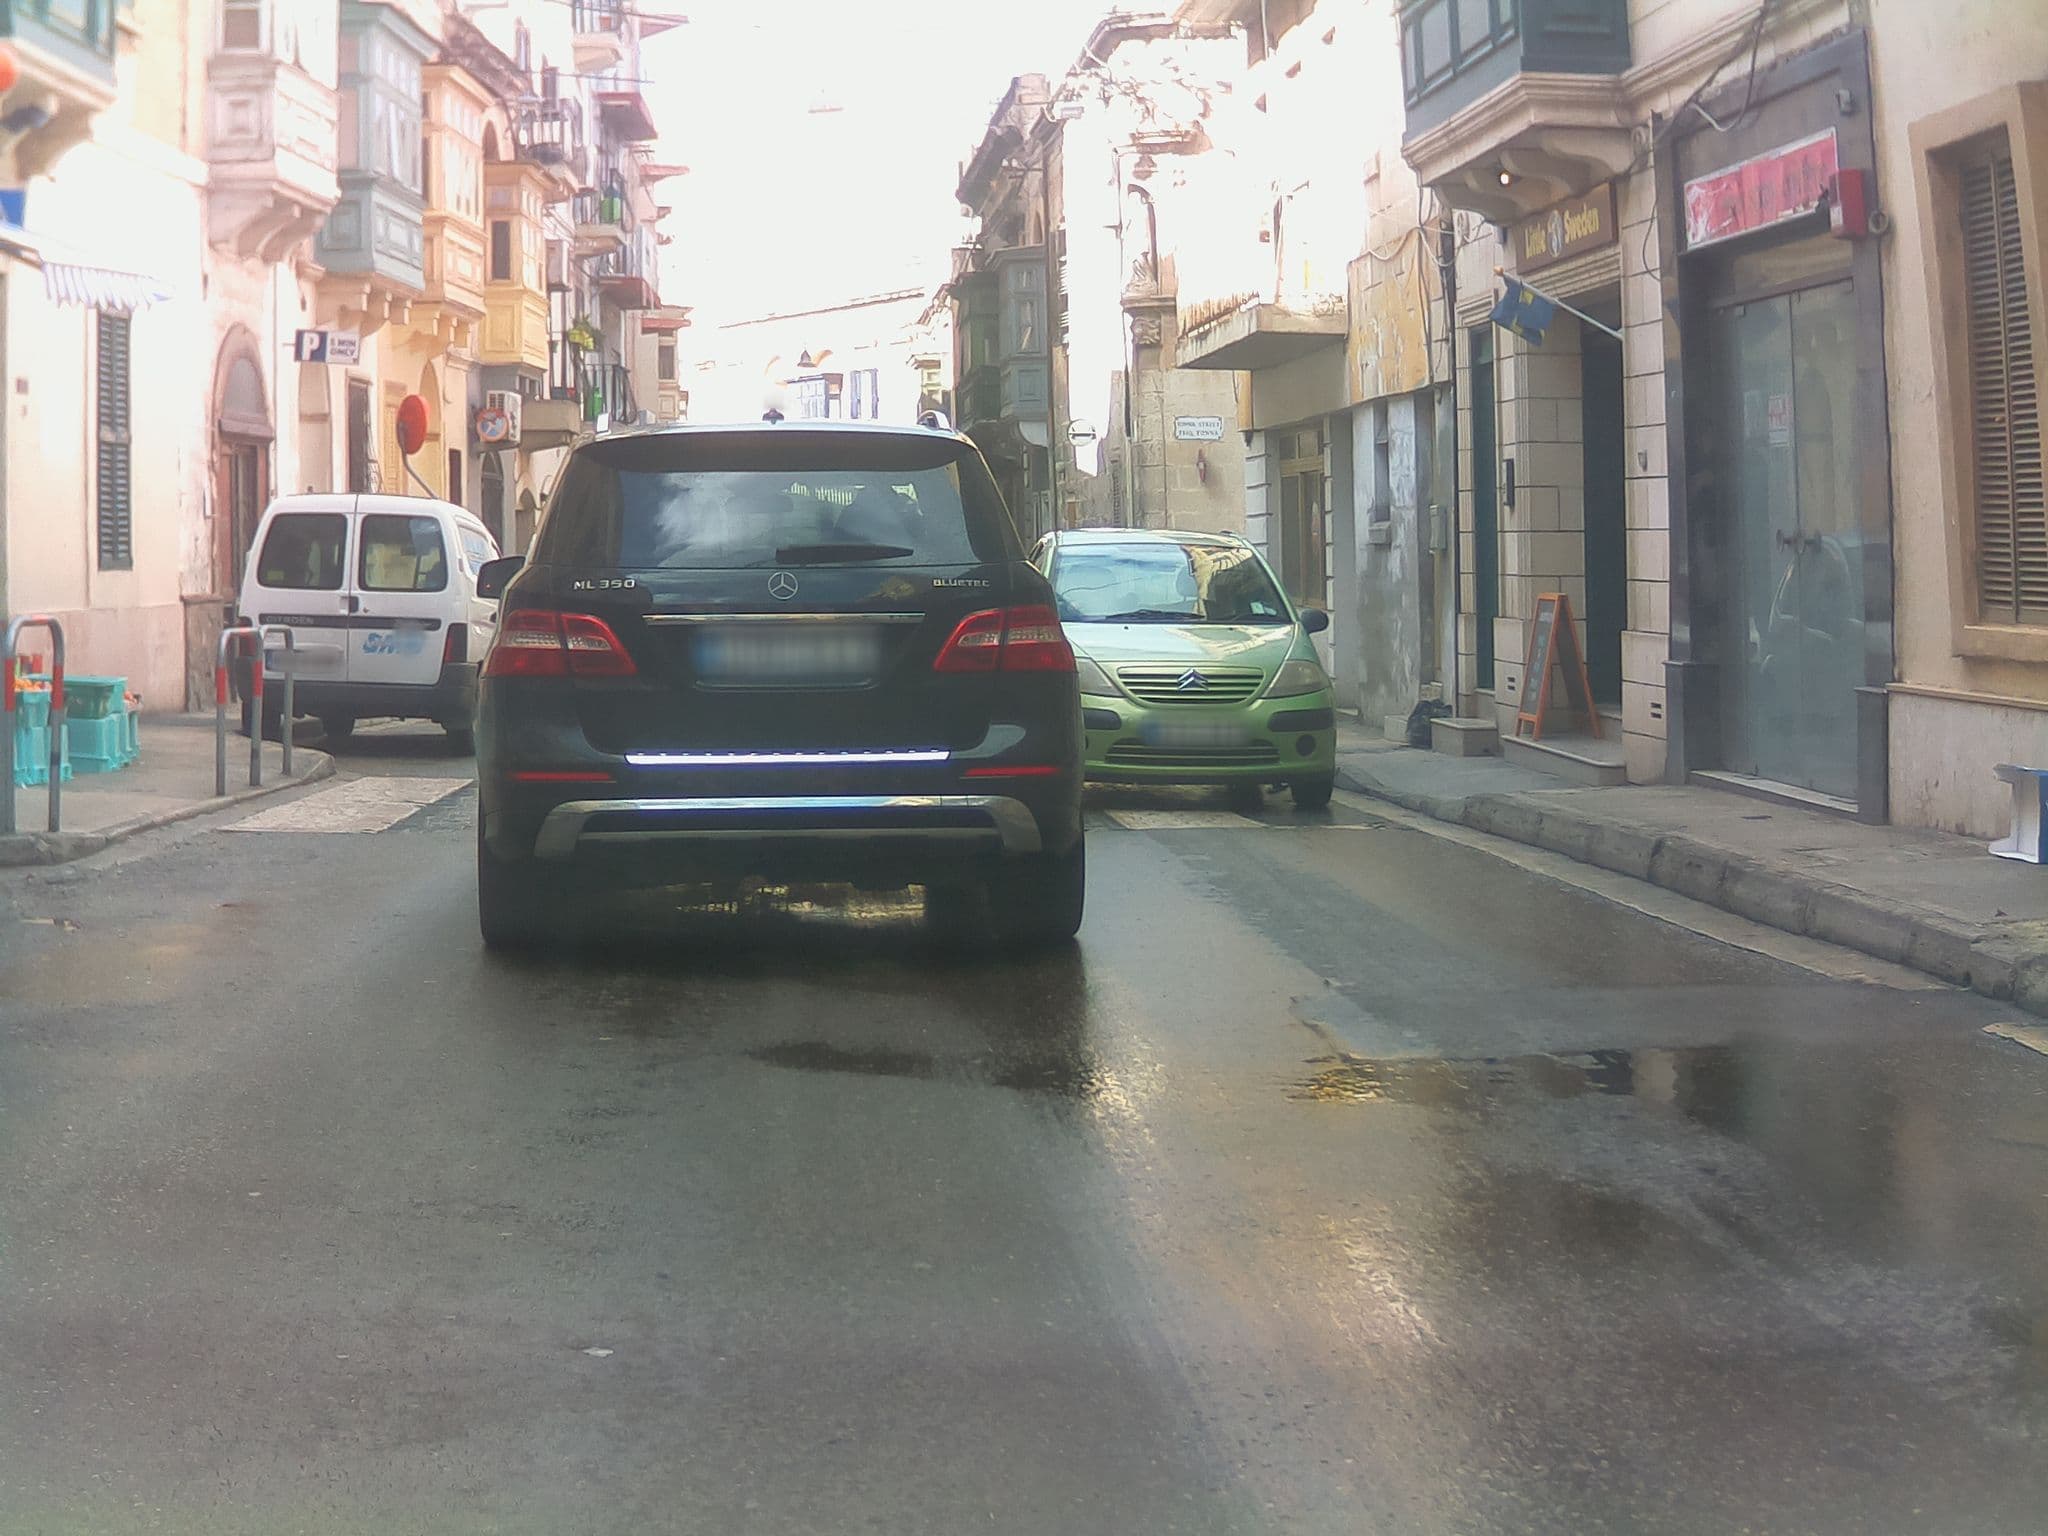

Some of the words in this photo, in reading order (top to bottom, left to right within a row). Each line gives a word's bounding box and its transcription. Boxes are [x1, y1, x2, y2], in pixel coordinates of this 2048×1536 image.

[1563, 203, 1600, 244] Sweden
[301, 332, 320, 361] P
[573, 580, 596, 590] ML
[599, 579, 636, 589] 350
[932, 579, 990, 587] BLUETEC
